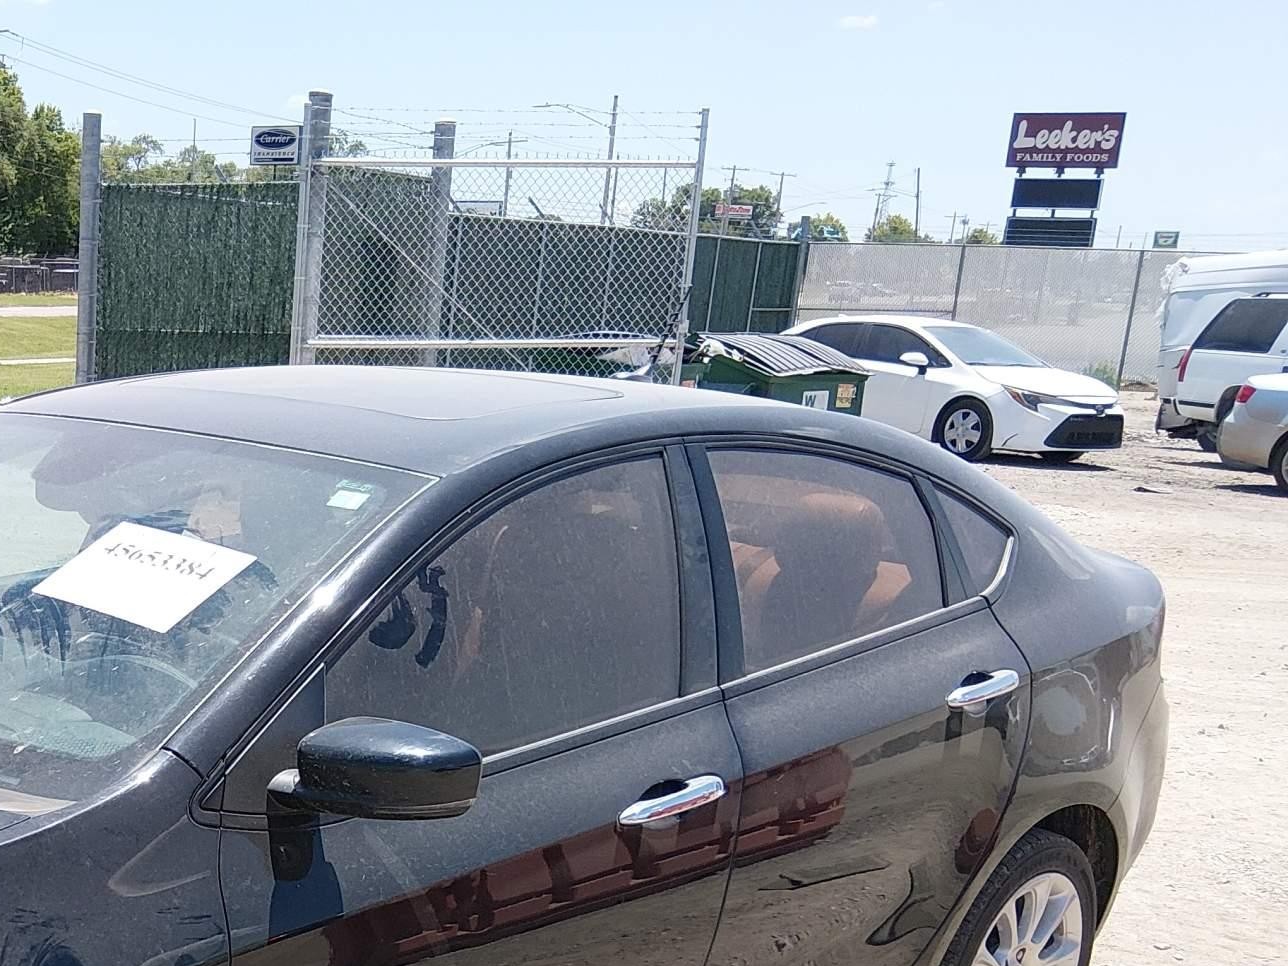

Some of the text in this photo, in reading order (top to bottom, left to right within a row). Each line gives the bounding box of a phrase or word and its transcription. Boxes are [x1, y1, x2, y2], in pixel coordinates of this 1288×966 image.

[260, 133, 291, 144] Carrier
[1013, 119, 1120, 150] Leeker's
[1016, 153, 1109, 162] FAMILY FOODS
[104, 543, 216, 581] 45653384
